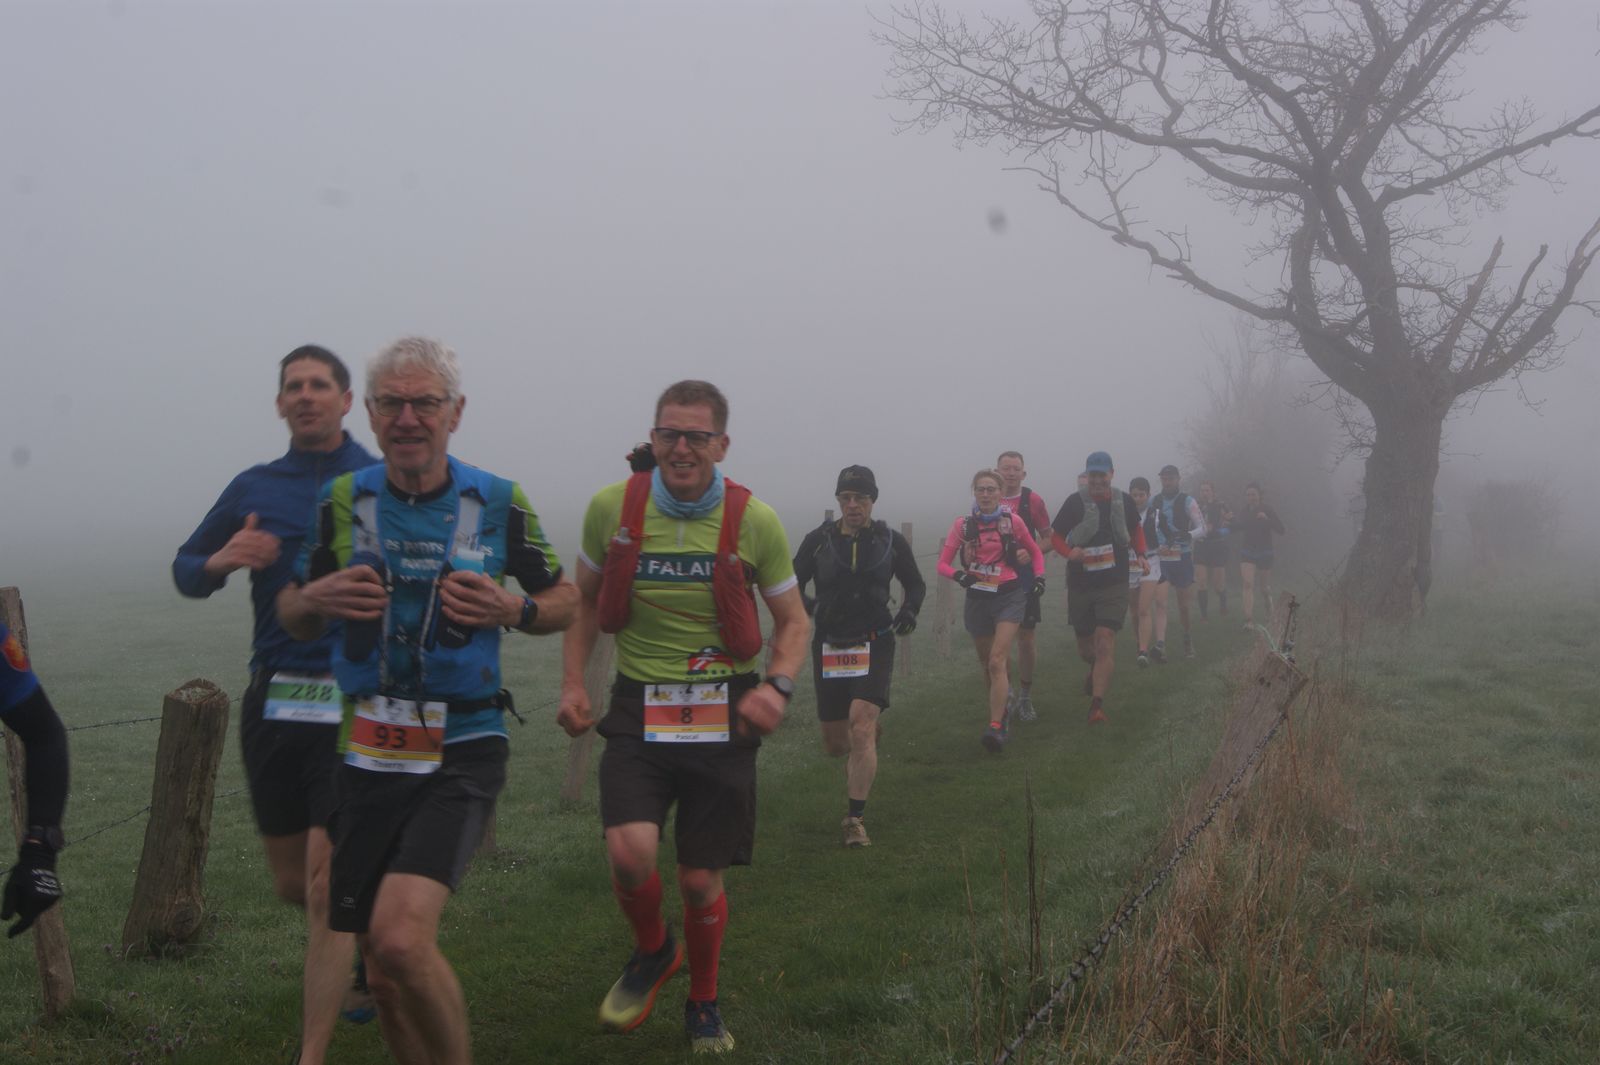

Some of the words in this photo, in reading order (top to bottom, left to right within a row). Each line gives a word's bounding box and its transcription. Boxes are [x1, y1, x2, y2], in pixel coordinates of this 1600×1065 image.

[835, 654, 858, 666] 108
[288, 683, 335, 703] 288
[680, 707, 693, 724] 8
[374, 725, 407, 749] 93
